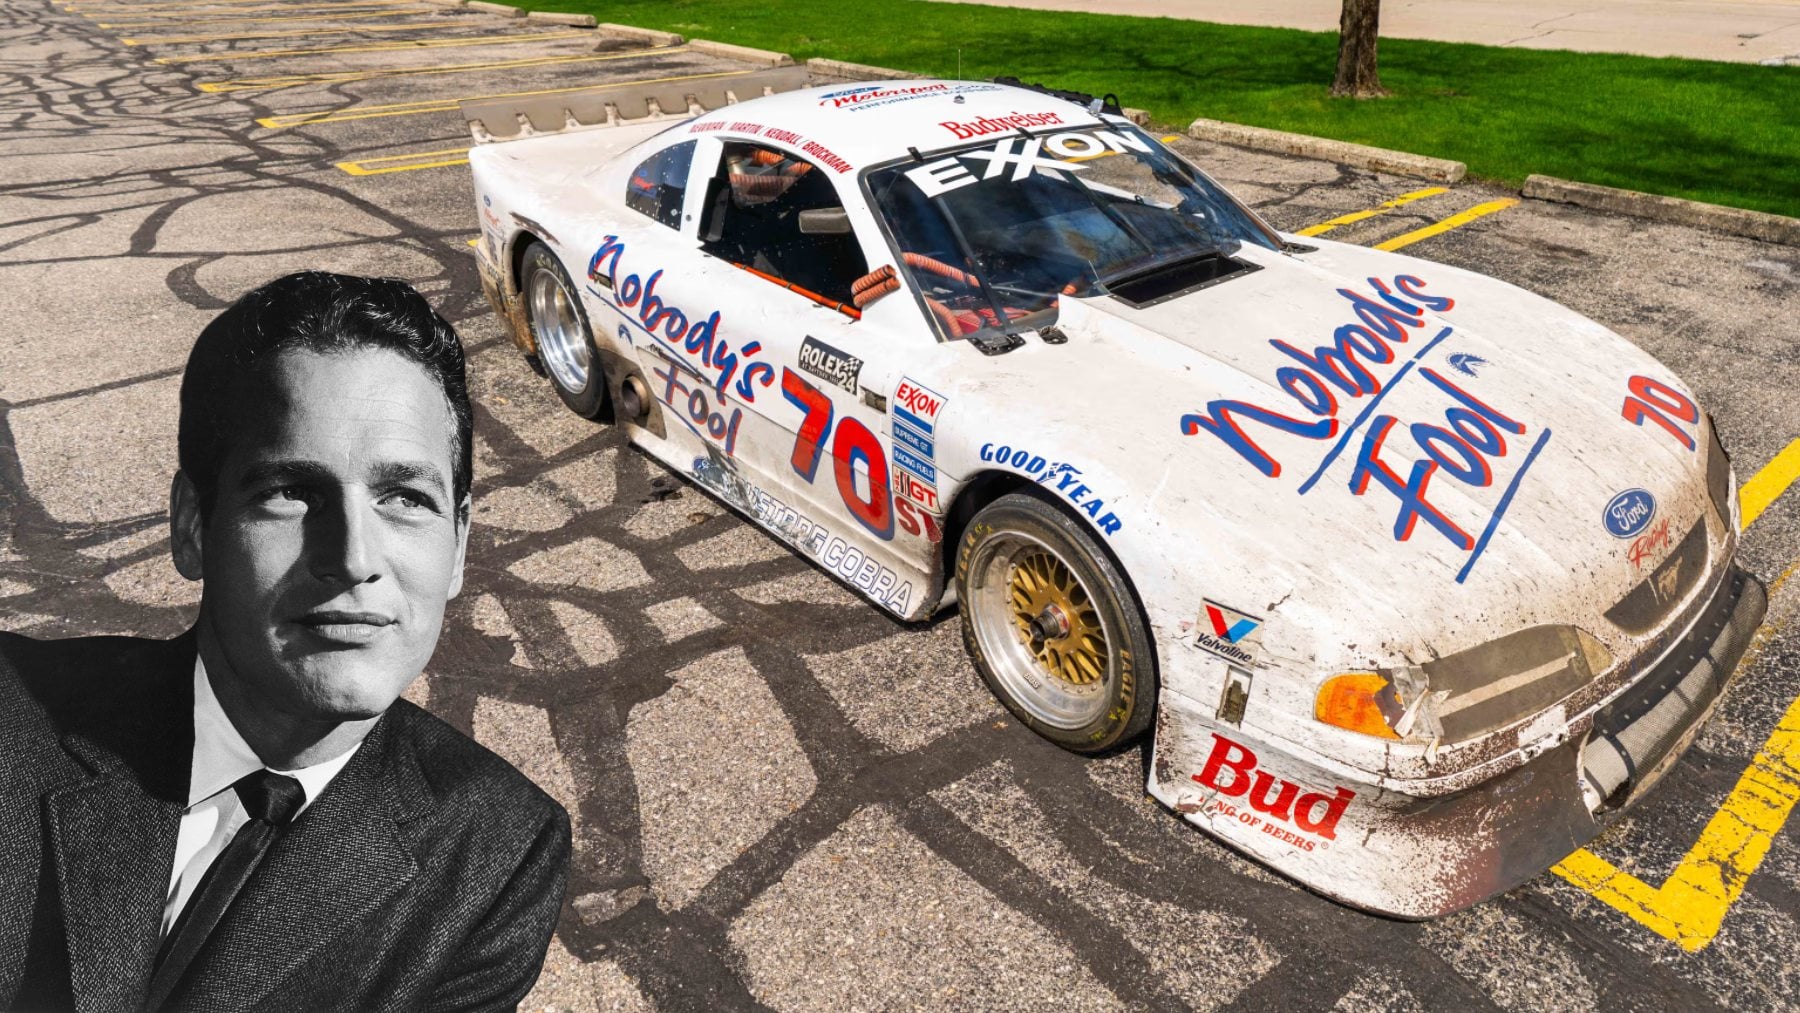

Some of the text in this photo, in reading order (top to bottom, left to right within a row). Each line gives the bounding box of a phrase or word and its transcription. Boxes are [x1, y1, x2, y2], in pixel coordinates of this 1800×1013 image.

[729, 121, 764, 135] MARTIN
[764, 126, 802, 146] KENDALL
[802, 140, 854, 174] BROCKMAN
[938, 110, 1065, 140] Budweiser
[904, 131, 1154, 199] EXXON
[588, 234, 775, 406] Nobody's
[800, 343, 844, 376] ROLEX
[837, 371, 856, 394] 24
[653, 363, 743, 457] Fool
[896, 382, 940, 417] EXXON
[1621, 375, 1699, 451] 70
[781, 365, 895, 541] 70
[895, 450, 934, 478] RACING FUELS
[1348, 367, 1526, 550] Fool
[911, 480, 937, 507] GT
[1613, 495, 1649, 532] Ford
[823, 536, 913, 616] COBRA
[1197, 632, 1253, 664] Valvoline
[1191, 732, 1357, 841] Bud
[1238, 812, 1262, 827] OF
[1261, 822, 1316, 852] BEERS
